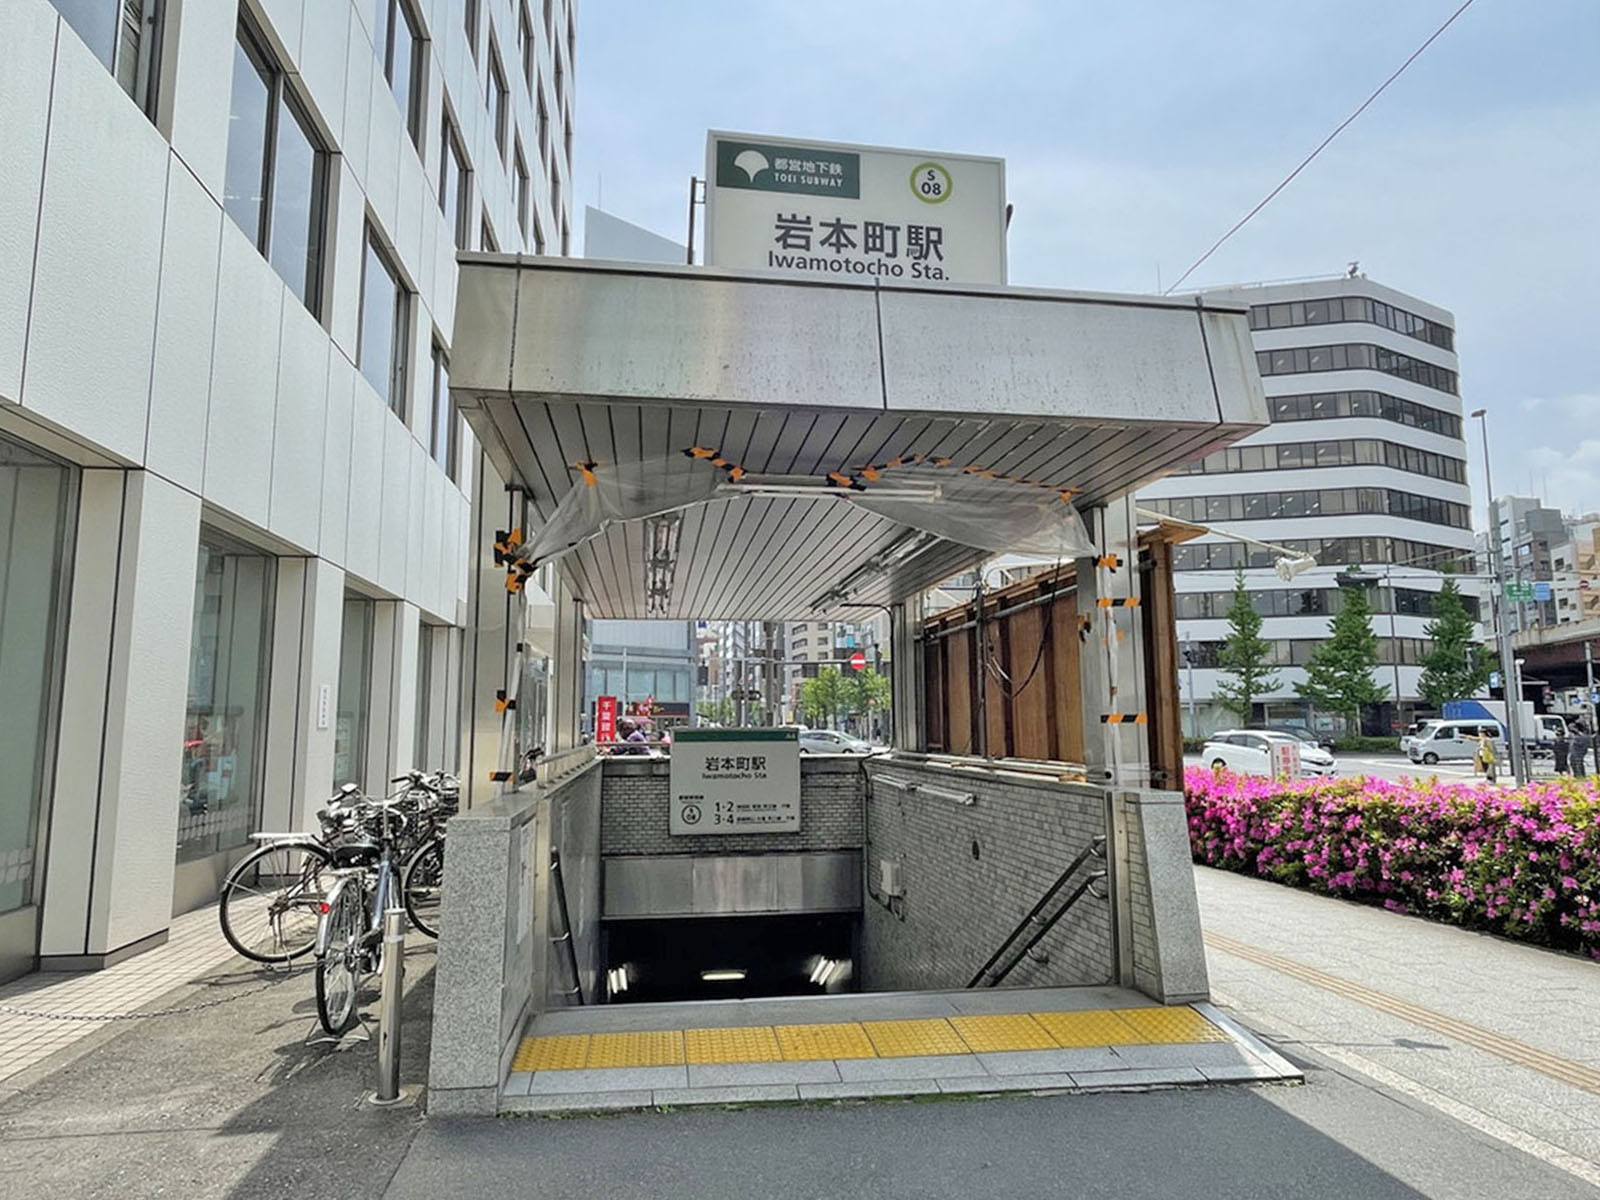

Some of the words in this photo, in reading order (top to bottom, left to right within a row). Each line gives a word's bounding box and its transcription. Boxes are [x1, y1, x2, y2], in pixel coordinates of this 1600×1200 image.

[774, 157, 843, 176] 都営地下鉄
[774, 173, 797, 184] TOEI
[801, 175, 843, 187] SUBWAY
[927, 169, 936, 181] S
[921, 182, 942, 196] 08
[774, 213, 944, 262] 岩本町駅
[768, 250, 904, 277] Iwamotocho
[911, 262, 950, 281] Sta.
[705, 756, 766, 771] 岩本町駅
